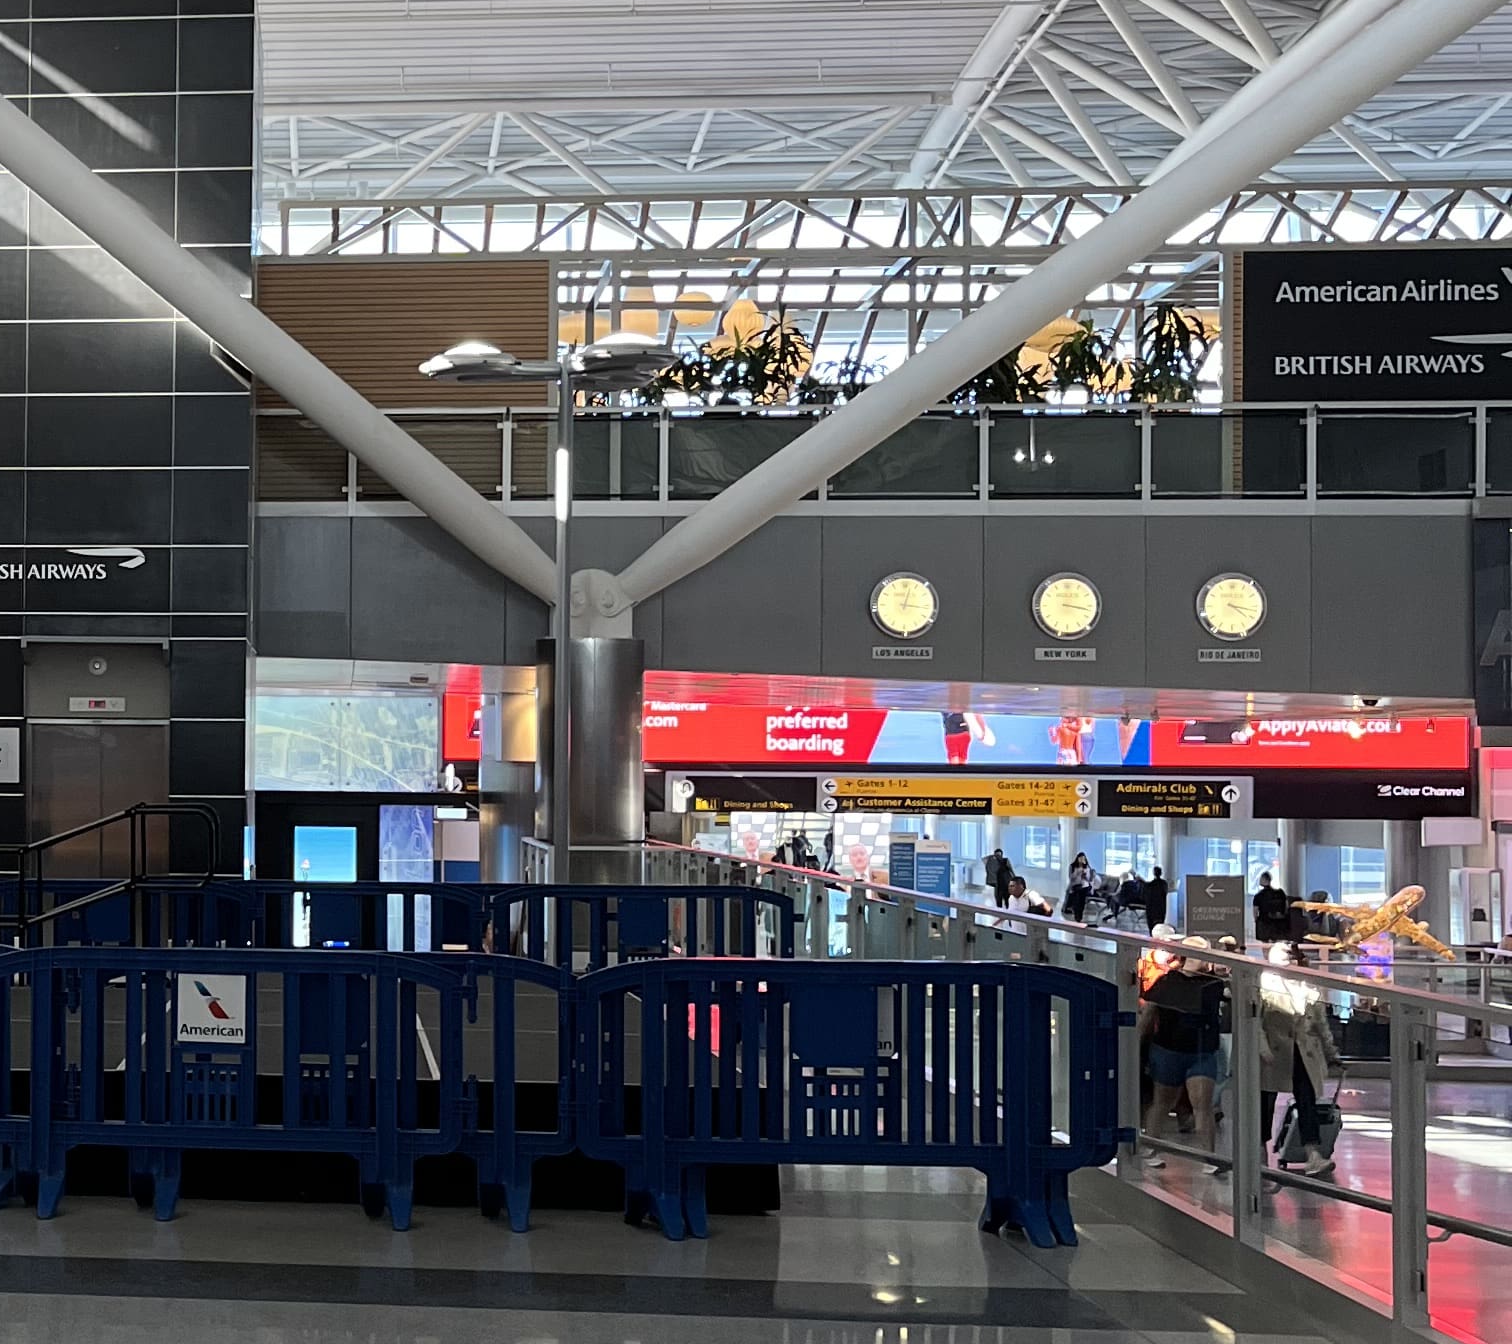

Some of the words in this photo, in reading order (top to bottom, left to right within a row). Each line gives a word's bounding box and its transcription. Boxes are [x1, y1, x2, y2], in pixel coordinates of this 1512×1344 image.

[1275, 281, 1397, 302] American
[1400, 279, 1499, 302] Airlines
[1274, 355, 1372, 376] BRITISH
[1378, 354, 1485, 375] AIRWAYS
[27, 563, 107, 580] AIRWAYS
[875, 649, 890, 657] LOS
[894, 649, 930, 657] ANGELES
[1044, 650, 1062, 658] NEW
[1065, 650, 1087, 658] YORK
[1200, 651, 1214, 659] RIO
[1215, 651, 1224, 659] DE
[1226, 651, 1260, 659] JANEIRO
[766, 711, 849, 733] preferred
[766, 733, 845, 756] boarding
[857, 779, 885, 788] Gates
[888, 779, 908, 788] 1-12
[997, 781, 1025, 790] Gates
[1028, 781, 1055, 790] 14-20
[1116, 783, 1167, 794] Admirals
[1170, 783, 1197, 794] Club
[1393, 785, 1420, 796] Clear
[1422, 785, 1465, 797] Channel
[723, 801, 750, 810] Dining
[752, 801, 767, 809] and
[769, 800, 794, 810] Shops
[857, 797, 902, 807] Customer
[904, 798, 953, 807] Assistance
[955, 798, 987, 808] Center
[996, 798, 1025, 807] Gates
[1028, 798, 1055, 807] 31-47
[1121, 804, 1149, 814] Dining
[1150, 804, 1166, 813] and
[1168, 805, 1194, 815] Shops
[179, 1023, 244, 1037] American
